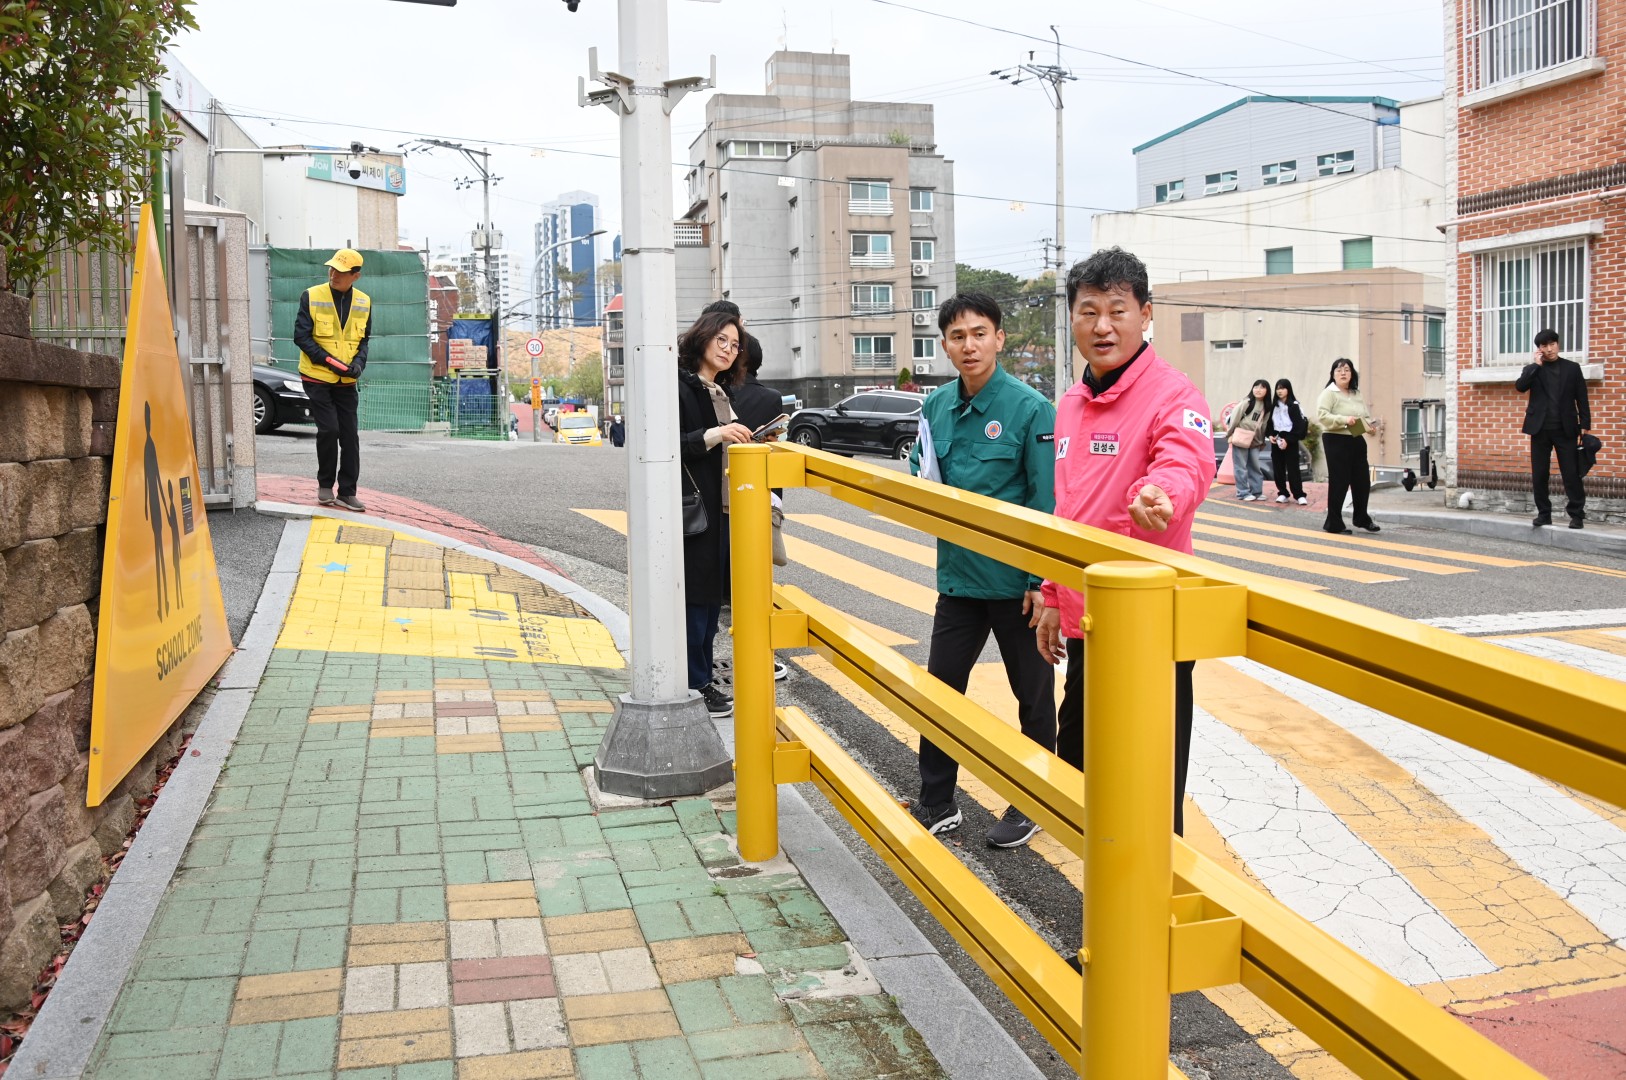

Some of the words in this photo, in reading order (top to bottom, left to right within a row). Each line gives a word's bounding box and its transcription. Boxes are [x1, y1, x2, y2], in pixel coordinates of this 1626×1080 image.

[530, 343, 540, 352] 30
[1093, 442, 1116, 453] 김성수
[156, 629, 187, 681] SCHOOL
[187, 614, 203, 654] ZONE
